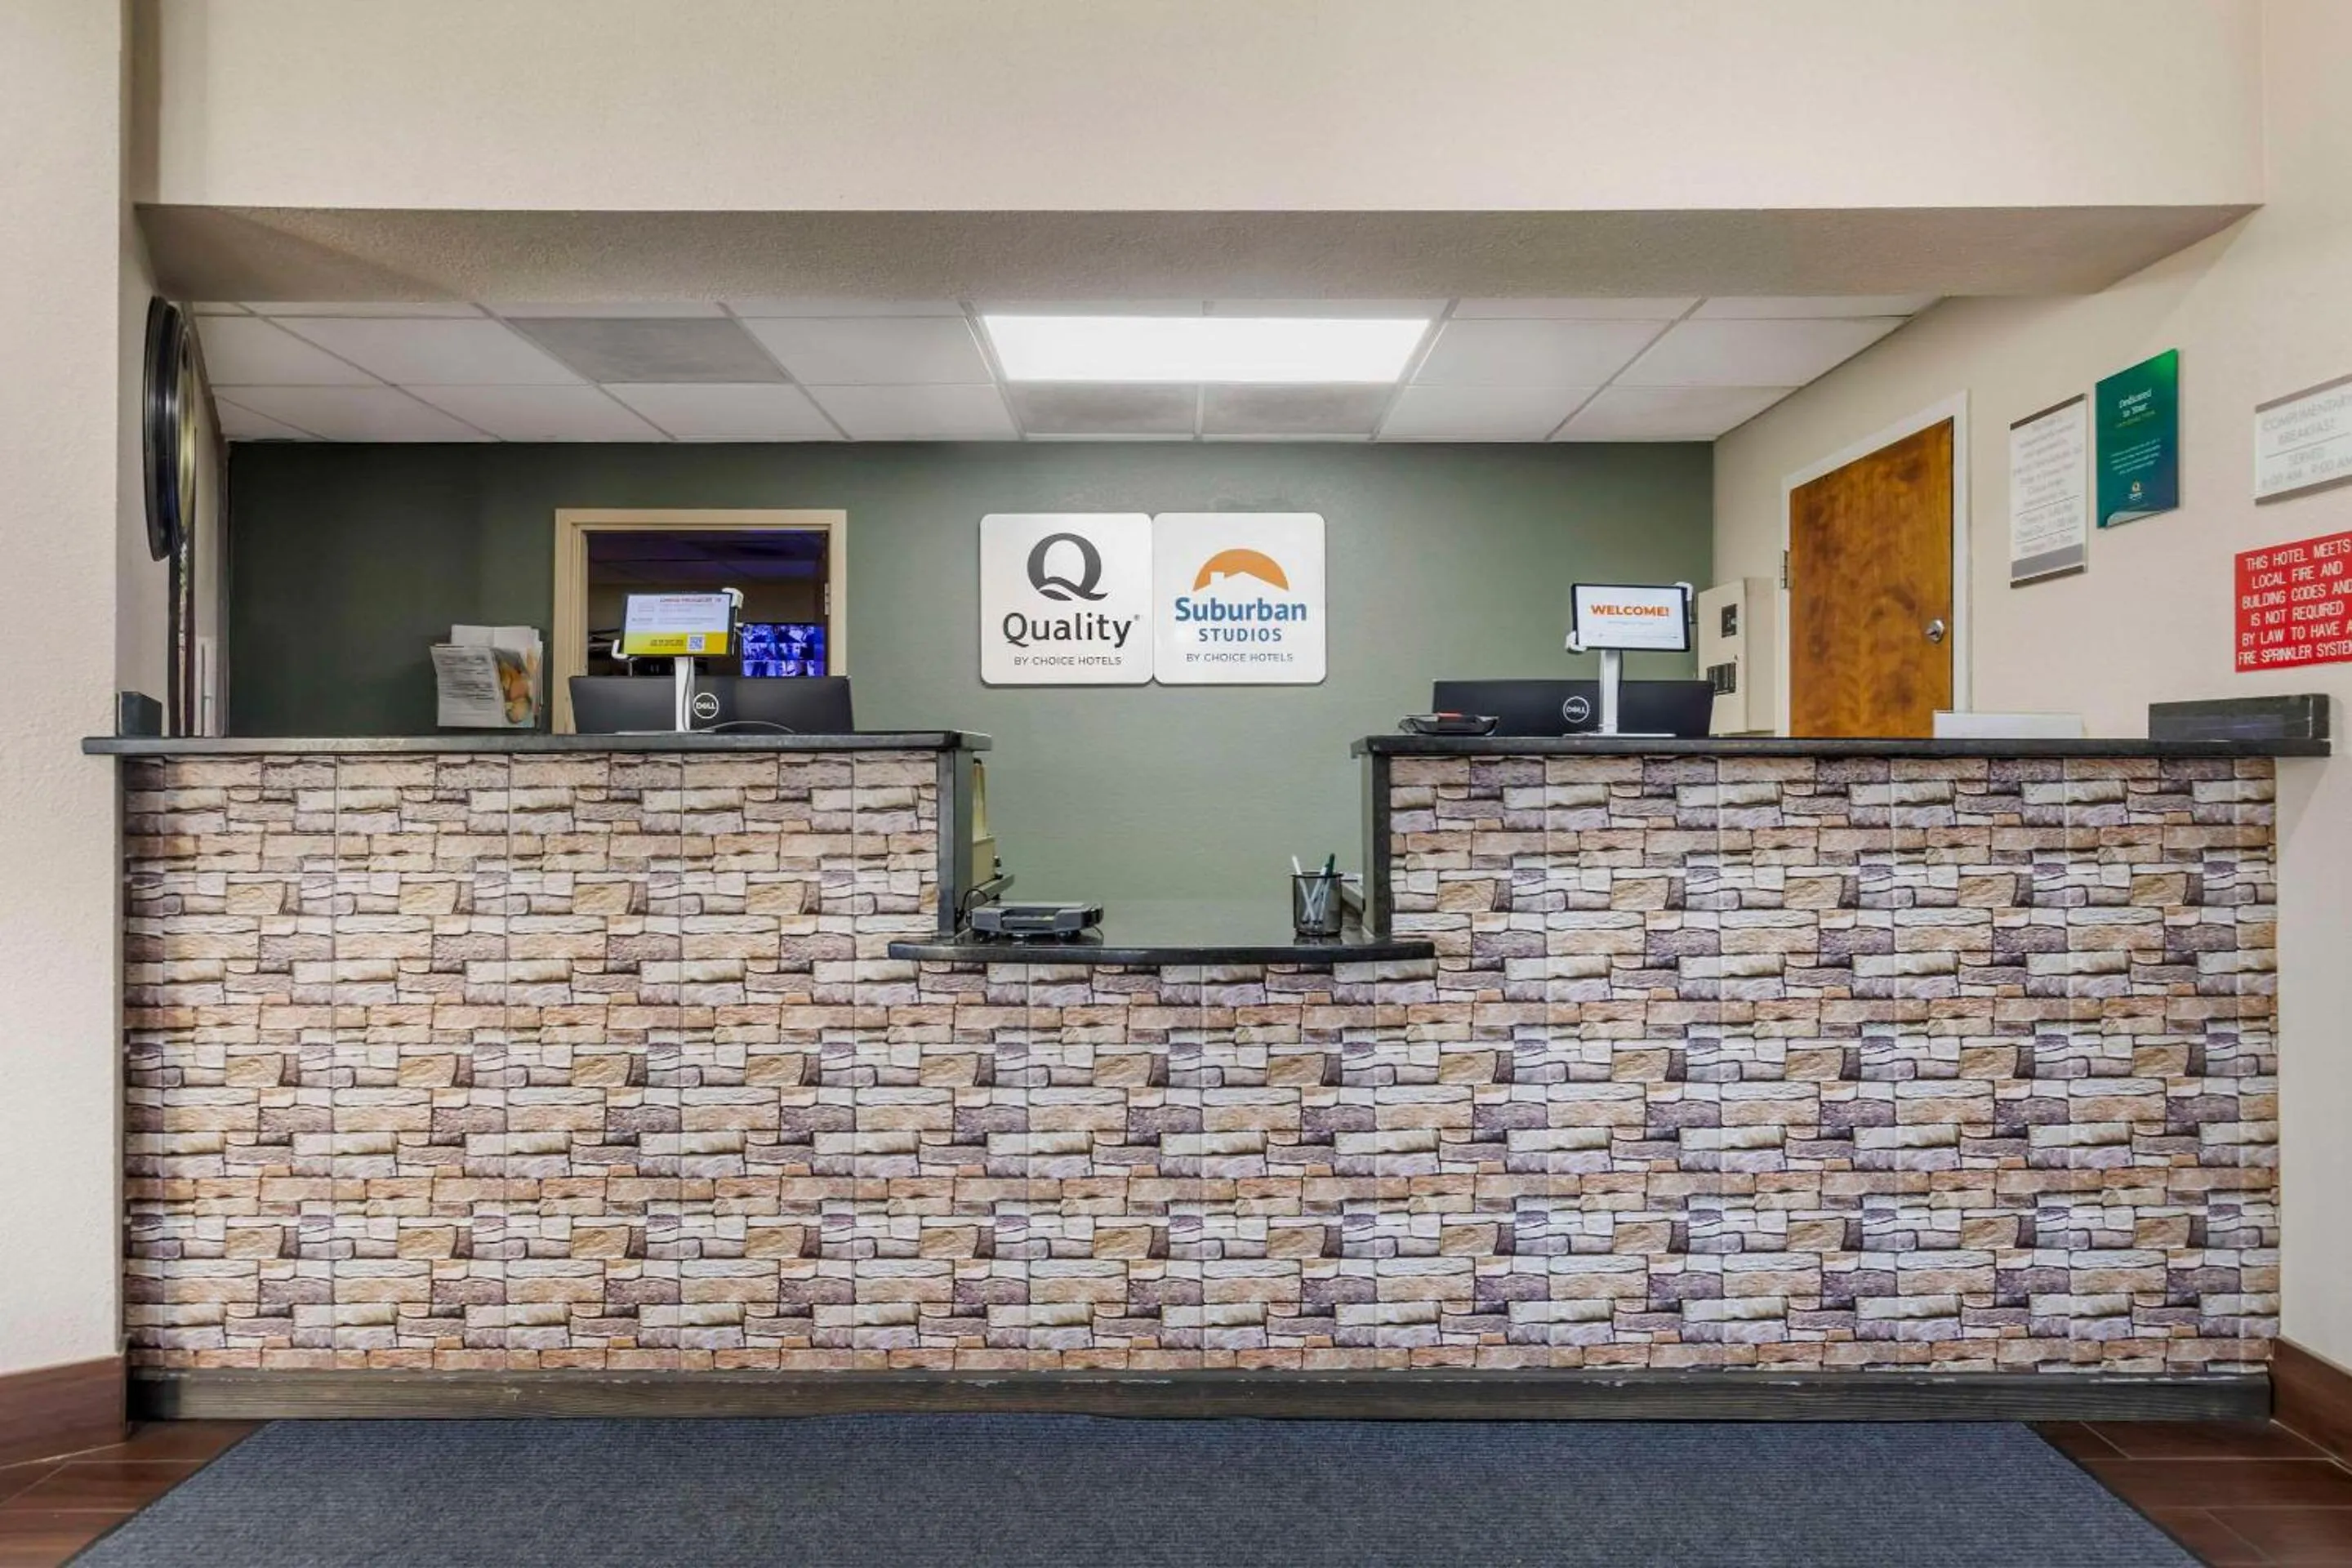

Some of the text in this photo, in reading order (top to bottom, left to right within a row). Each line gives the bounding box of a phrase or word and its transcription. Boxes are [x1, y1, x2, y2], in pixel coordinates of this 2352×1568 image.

[2246, 539, 2351, 572] THIS HOTEL MEETS
[2252, 561, 2343, 589] LOCAL FIRE AND
[2242, 578, 2352, 610] BUILDING CODES AND
[1175, 597, 1307, 621] Suburban
[1591, 604, 1669, 617] WELCOME!
[2251, 600, 2345, 626] IS NOT REQUIRED
[1003, 612, 1132, 648] Quality
[1198, 628, 1282, 642] STUDIOS
[2242, 633, 2255, 647] BY
[2261, 629, 2285, 644] LAW
[2290, 626, 2305, 640] TO
[2310, 621, 2340, 638] HAVE
[1014, 656, 1121, 666] BY CHOICE HOTELS
[1186, 653, 1294, 662] BY CHOICE HOTELS
[2238, 650, 2257, 665] FIRE
[2261, 645, 2312, 663] SPRINKLER
